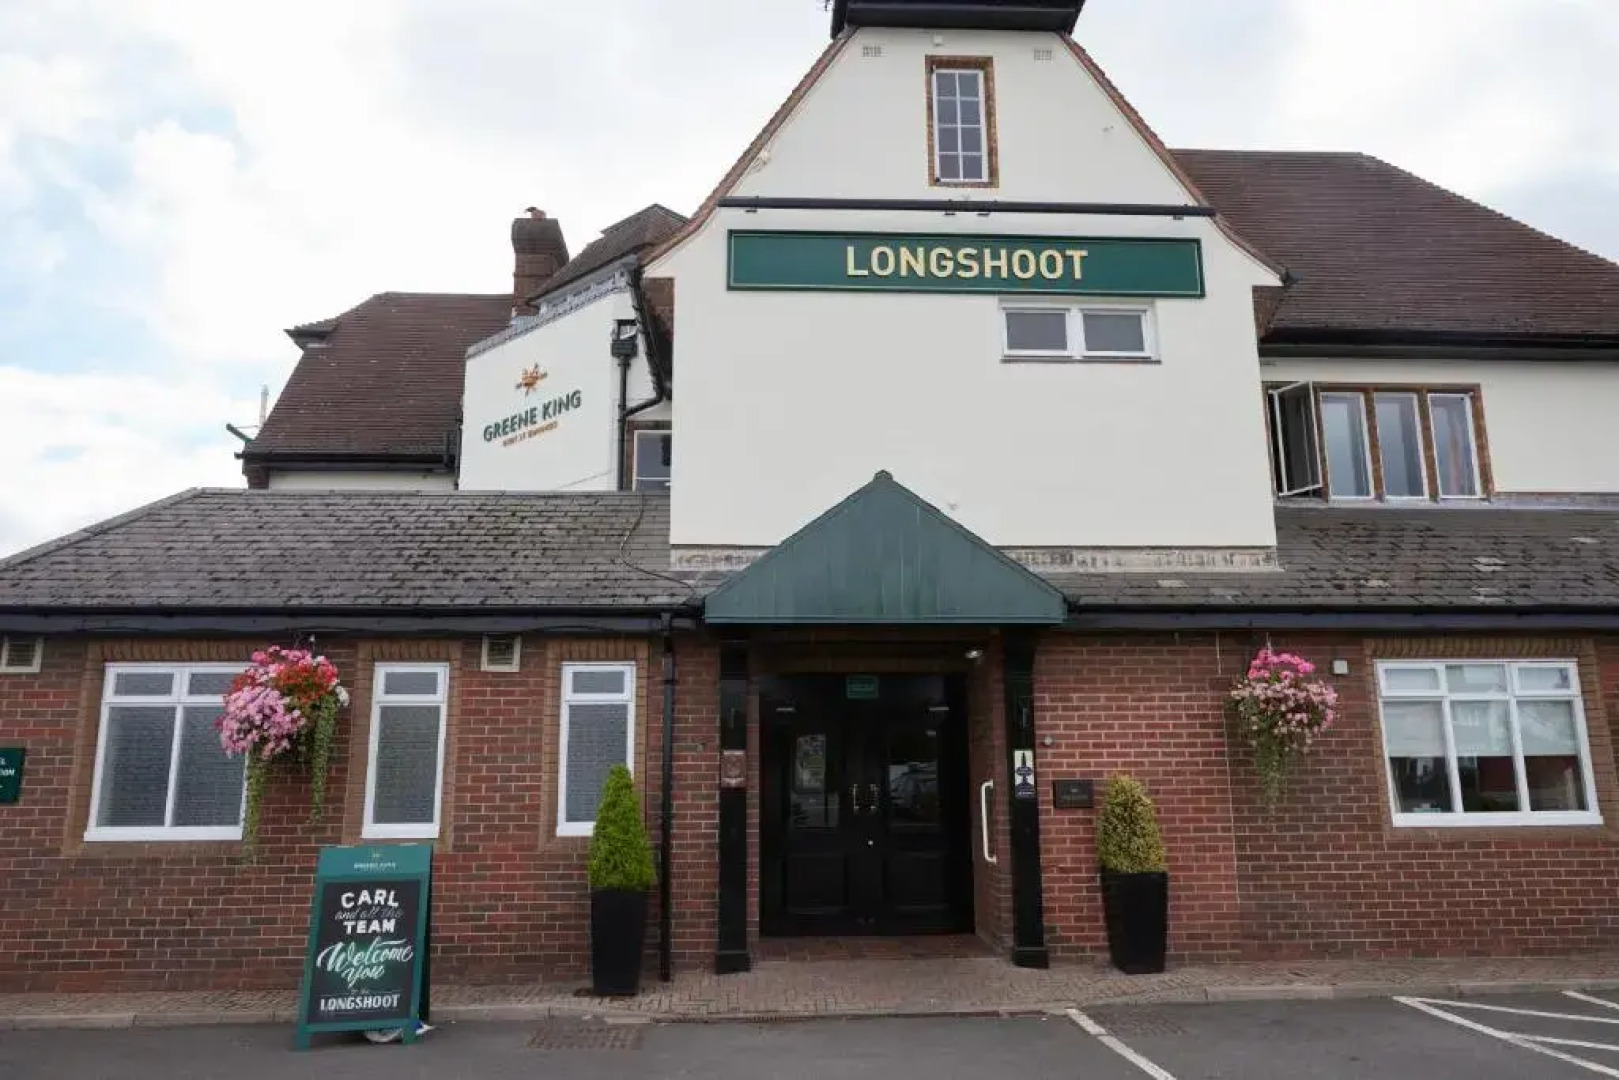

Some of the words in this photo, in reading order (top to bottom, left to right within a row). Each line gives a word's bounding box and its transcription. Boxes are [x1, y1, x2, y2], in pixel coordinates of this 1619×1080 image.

[846, 246, 1088, 279] LONGSHOOT
[483, 406, 538, 442] GREENE
[542, 389, 582, 420] KING
[341, 889, 399, 909] CARL
[343, 919, 396, 935] TEAM
[316, 936, 414, 972] Welcome
[320, 994, 400, 1011] LONGSHOOT
